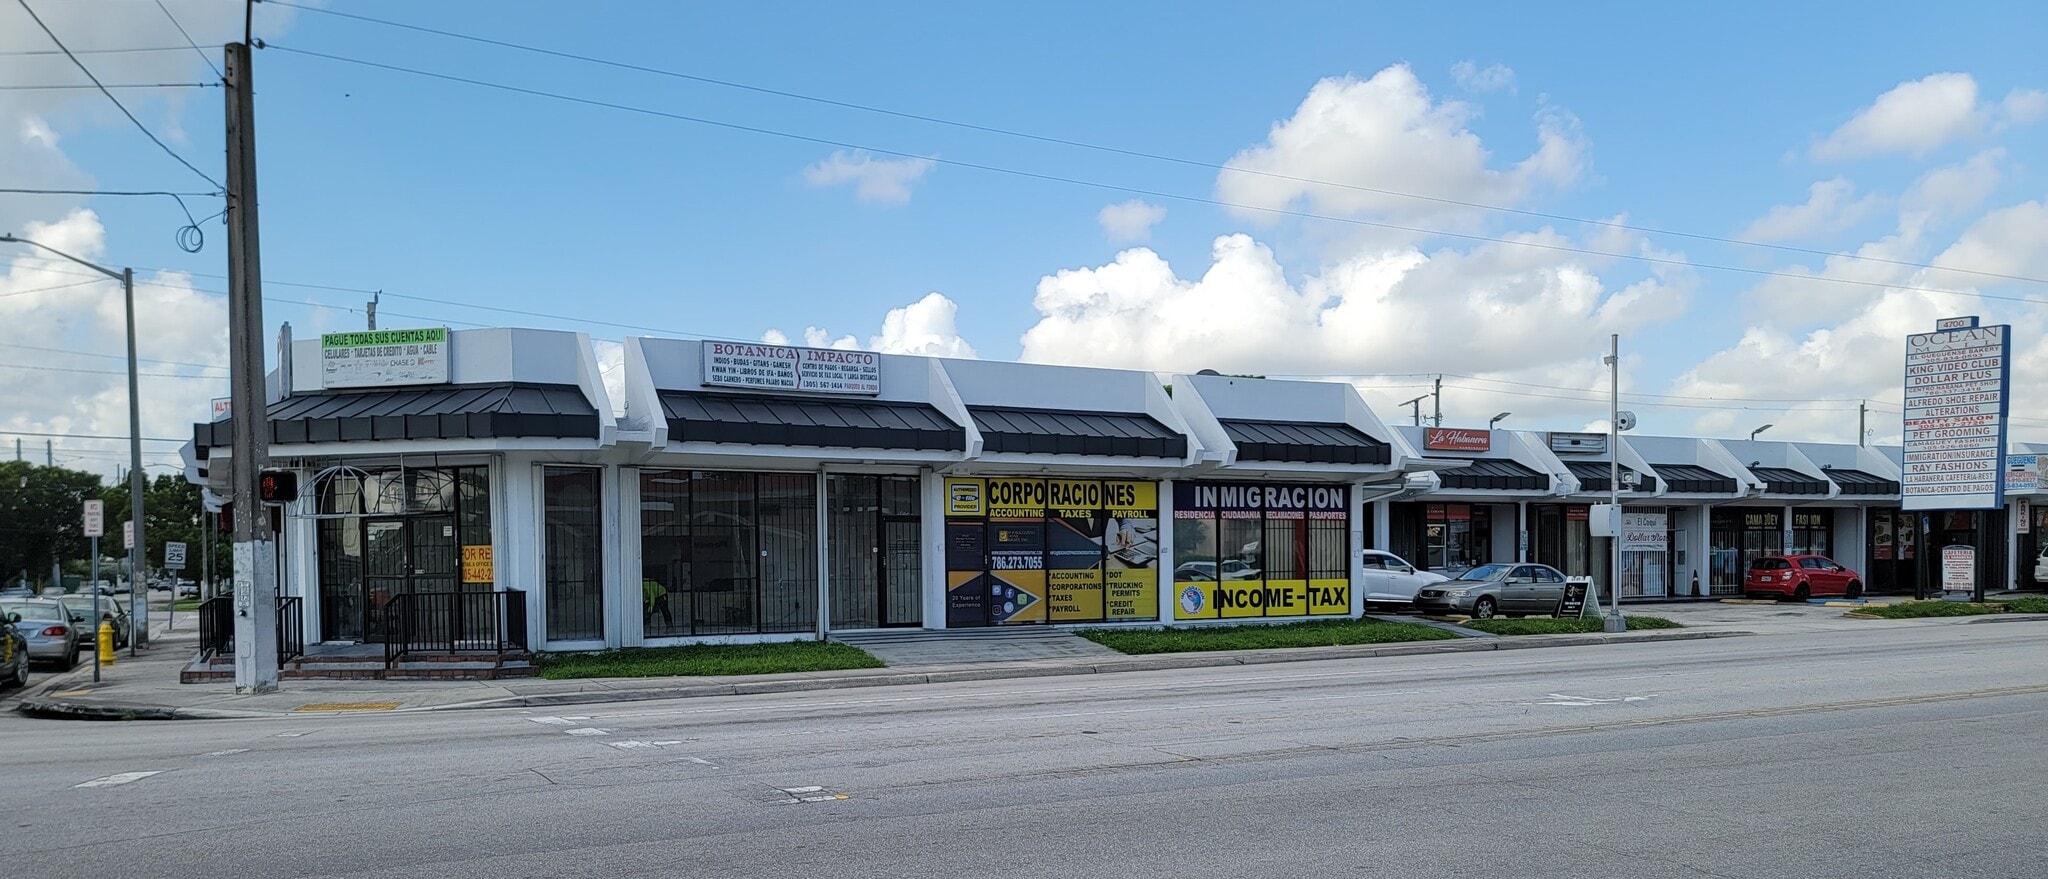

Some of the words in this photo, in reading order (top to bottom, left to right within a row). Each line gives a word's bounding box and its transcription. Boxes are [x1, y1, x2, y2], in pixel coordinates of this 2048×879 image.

[1943, 320, 1964, 328] 4700
[325, 334, 348, 346] PAGUE
[350, 333, 373, 345] TODAS
[375, 332, 389, 343] SUS
[390, 331, 425, 343] CUENTAS
[426, 330, 444, 341] AQUI
[1911, 327, 1997, 347] OCEAN
[324, 348, 350, 359] CELULARES
[354, 347, 376, 358] TARJETAS
[377, 347, 383, 357] DE
[383, 346, 402, 356] CREDITO
[406, 345, 419, 355] AGUA
[423, 344, 437, 355] CABLE
[713, 344, 795, 359] BOTANICA
[807, 351, 873, 365] IMPACTO
[1968, 346, 1999, 354] BAKERY
[390, 359, 409, 367] CHASE
[713, 357, 730, 365] INDIOS
[733, 358, 749, 366] BUDAS
[1909, 365, 1934, 375] KING
[1937, 361, 1968, 372] VIDEO
[1971, 358, 1998, 368] CLUB
[712, 366, 726, 374] KWAN
[728, 366, 736, 374] YIN
[740, 367, 757, 375] LIBROS
[802, 362, 817, 370] CENTRO
[818, 363, 824, 371] DE
[862, 366, 877, 374] SELLOS
[745, 377, 764, 385] PERFUMES
[1914, 373, 1959, 385] DOLLAR
[1962, 370, 1992, 381] PLUS
[803, 380, 818, 388] (305)
[1908, 397, 1943, 408] ALFREDO
[1945, 395, 1966, 405] SHOE
[1969, 393, 1998, 402] REPAIR
[1925, 406, 1980, 417] ALTERATIONS
[1905, 418, 1949, 426] BEAUTY
[1954, 415, 1994, 423] SALON
[1429, 430, 1444, 445] La
[1446, 430, 1488, 445] Habanera
[1913, 431, 1931, 439] PET
[1934, 427, 1990, 438] GROOMING
[2006, 456, 2037, 464] GUEGUENSE
[1912, 464, 1932, 472] RAY
[1935, 461, 1988, 471] FASHIONS
[1906, 475, 1913, 483] LA
[1913, 474, 1944, 482] HABANERA
[1945, 472, 1993, 481] CAFETERIA-REST
[990, 481, 1135, 506] CORPORACIONES
[1905, 485, 1961, 494] BOTANICA-CENTRO
[1972, 483, 1993, 491] PAGOS
[1195, 486, 1343, 508] INMIGRACION
[989, 508, 1044, 518] ACCOUNTING
[1059, 509, 1091, 518] TAXES
[1112, 510, 1149, 518] PAYROLL
[1174, 510, 1215, 519] RESIDENCIA
[1221, 511, 1261, 519] CIUDADANIA
[1266, 511, 1304, 519] RECLAMACIONES
[1309, 511, 1347, 519] PASAPORTES
[1637, 517, 1642, 526] El
[1627, 532, 1650, 542] Dollar
[168, 553, 184, 561] 25
[462, 548, 476, 560] OR
[991, 556, 1042, 569] 786.273.7055
[1051, 572, 1095, 580] ACCOUNTING
[1051, 582, 1102, 591] CORPORATIONS
[1052, 594, 1073, 602] TAXES
